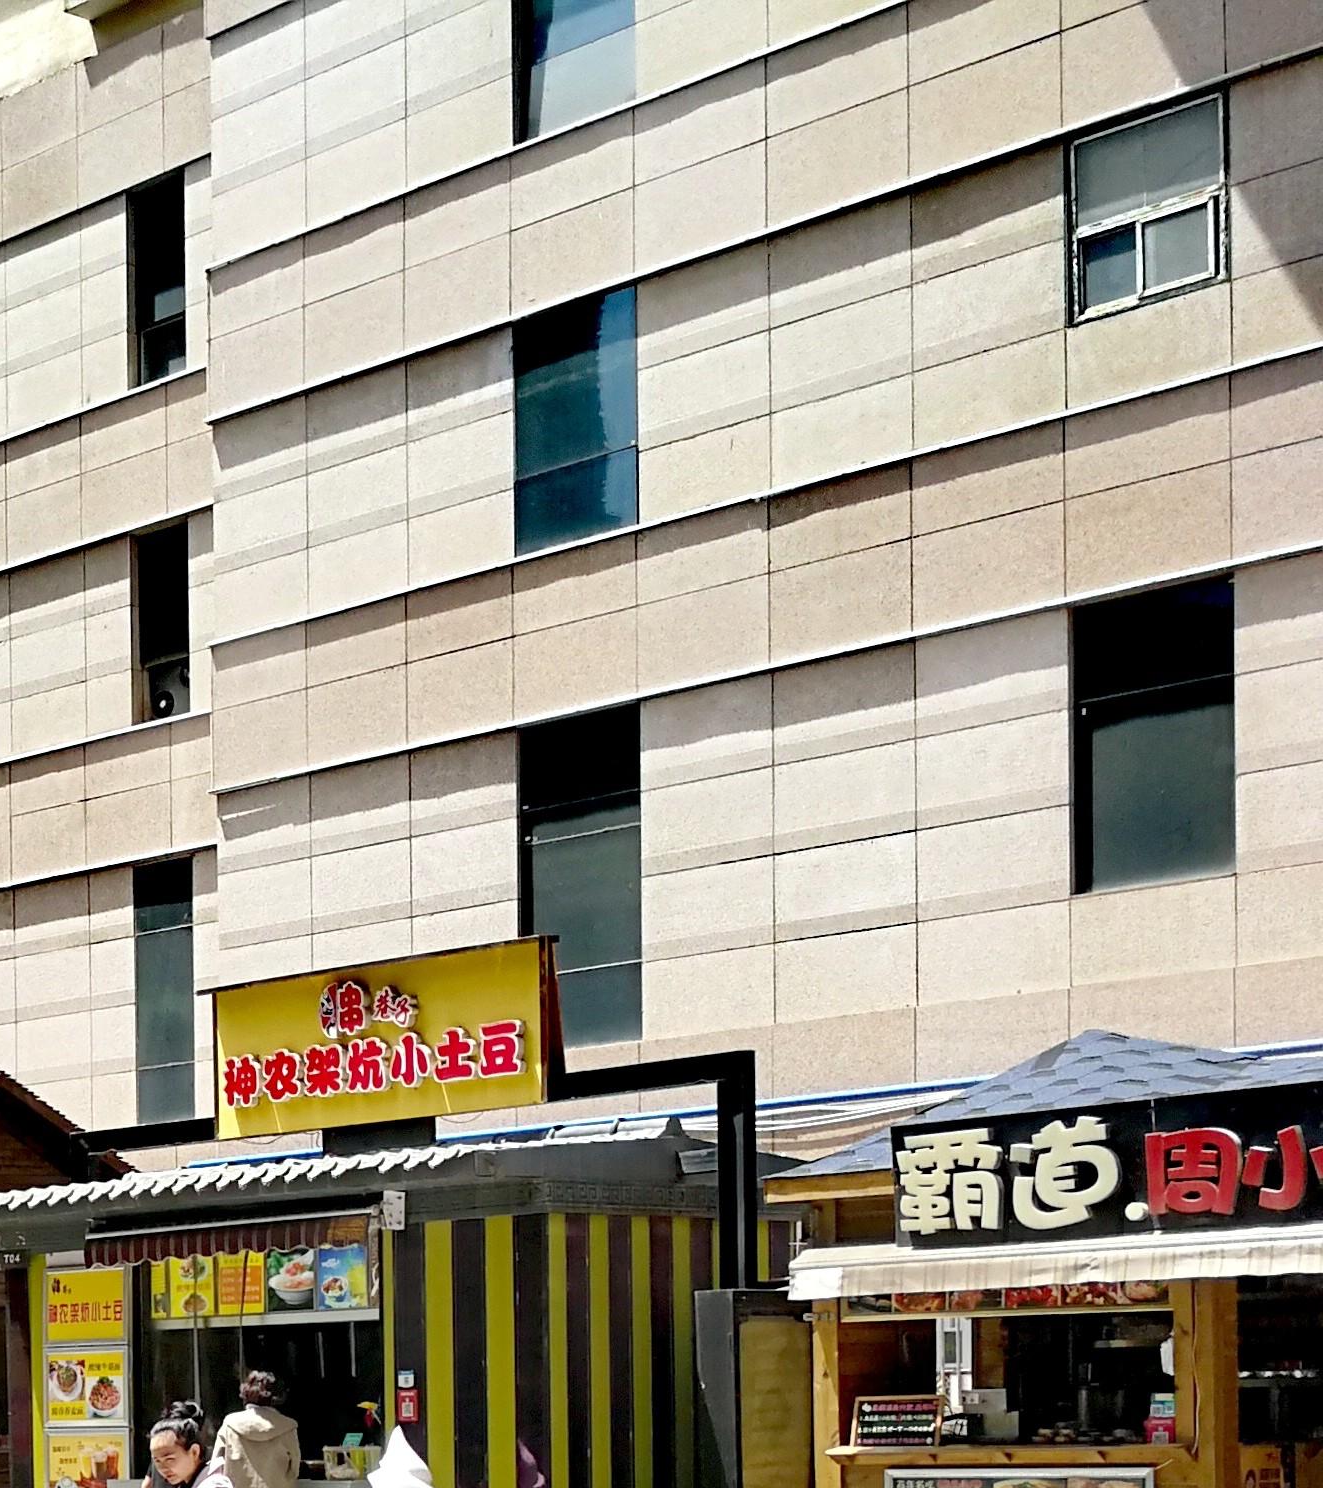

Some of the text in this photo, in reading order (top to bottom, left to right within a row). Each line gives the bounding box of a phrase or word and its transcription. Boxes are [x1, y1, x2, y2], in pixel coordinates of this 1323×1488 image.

[223, 1020, 523, 1108] 神农架炕小土豆
